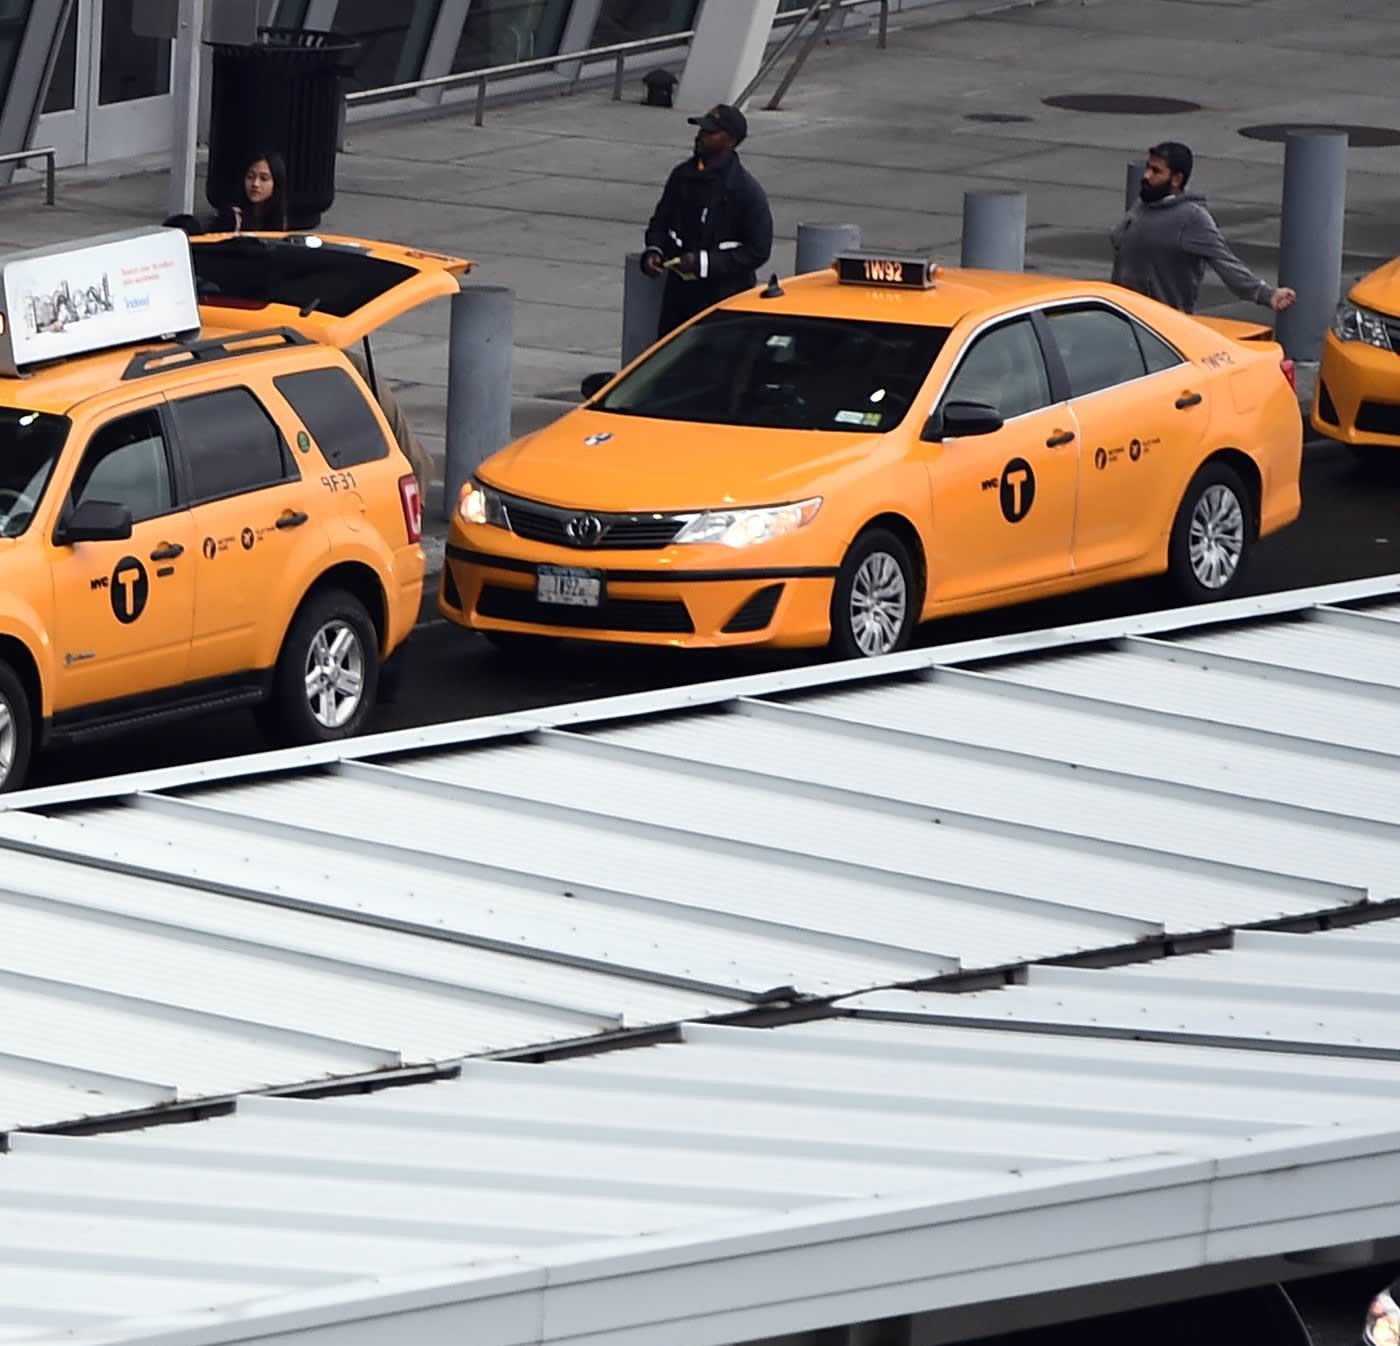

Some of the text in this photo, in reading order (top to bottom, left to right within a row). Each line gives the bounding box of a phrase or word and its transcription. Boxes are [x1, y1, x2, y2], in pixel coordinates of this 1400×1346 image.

[863, 259, 903, 282] 1W92
[320, 471, 357, 494] 9F31
[90, 576, 109, 591] NYC
